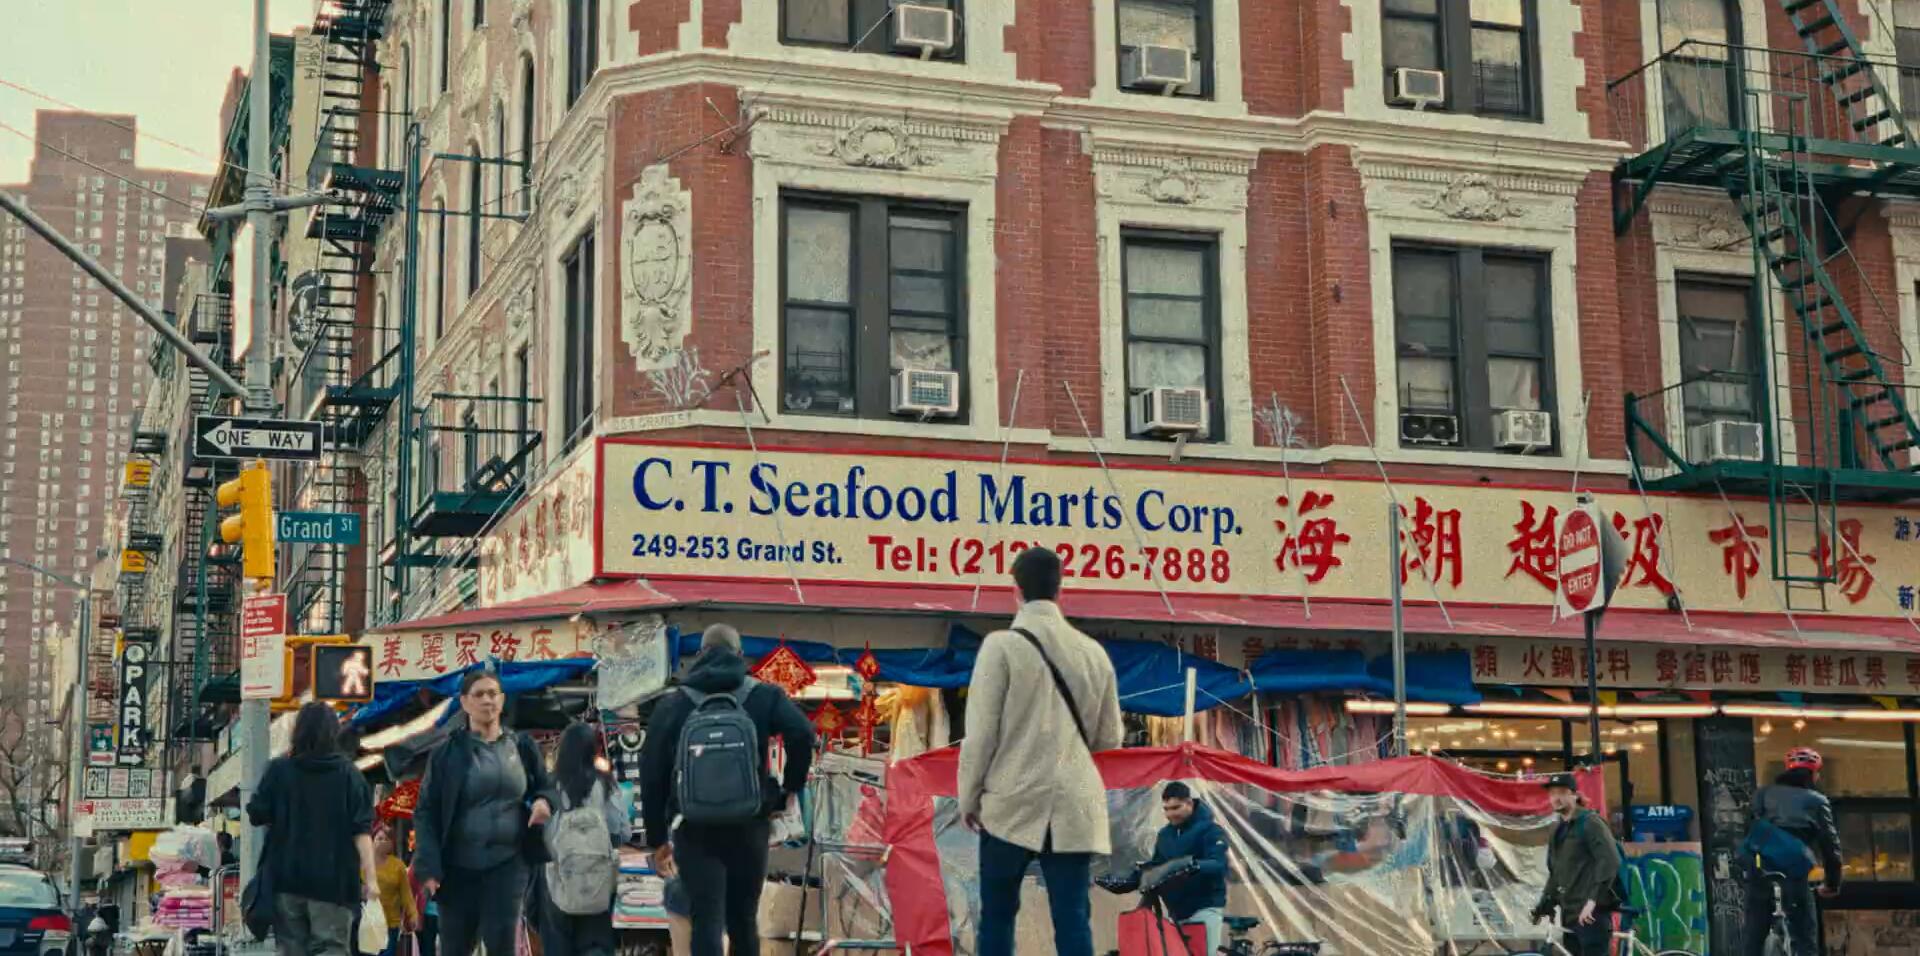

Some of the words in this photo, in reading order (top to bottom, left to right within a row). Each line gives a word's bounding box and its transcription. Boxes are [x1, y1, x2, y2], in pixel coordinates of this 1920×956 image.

[216, 429, 249, 446] ONE
[269, 432, 304, 447] WAY
[750, 463, 958, 523] Seafood
[978, 473, 1121, 529] Marts
[1136, 490, 1242, 546] Corp.
[281, 516, 332, 540] Grand
[341, 518, 353, 532] St
[1563, 532, 1575, 552] DO
[1576, 525, 1591, 546] NOT
[633, 534, 730, 558] 249-253
[737, 538, 805, 562] Grand
[812, 541, 843, 565] St.
[867, 535, 938, 573] Tel:
[950, 538, 1040, 576] (21
[1056, 543, 1231, 584] 226-7888
[1568, 573, 1592, 595] ENTER
[1648, 805, 1675, 817] ATM
